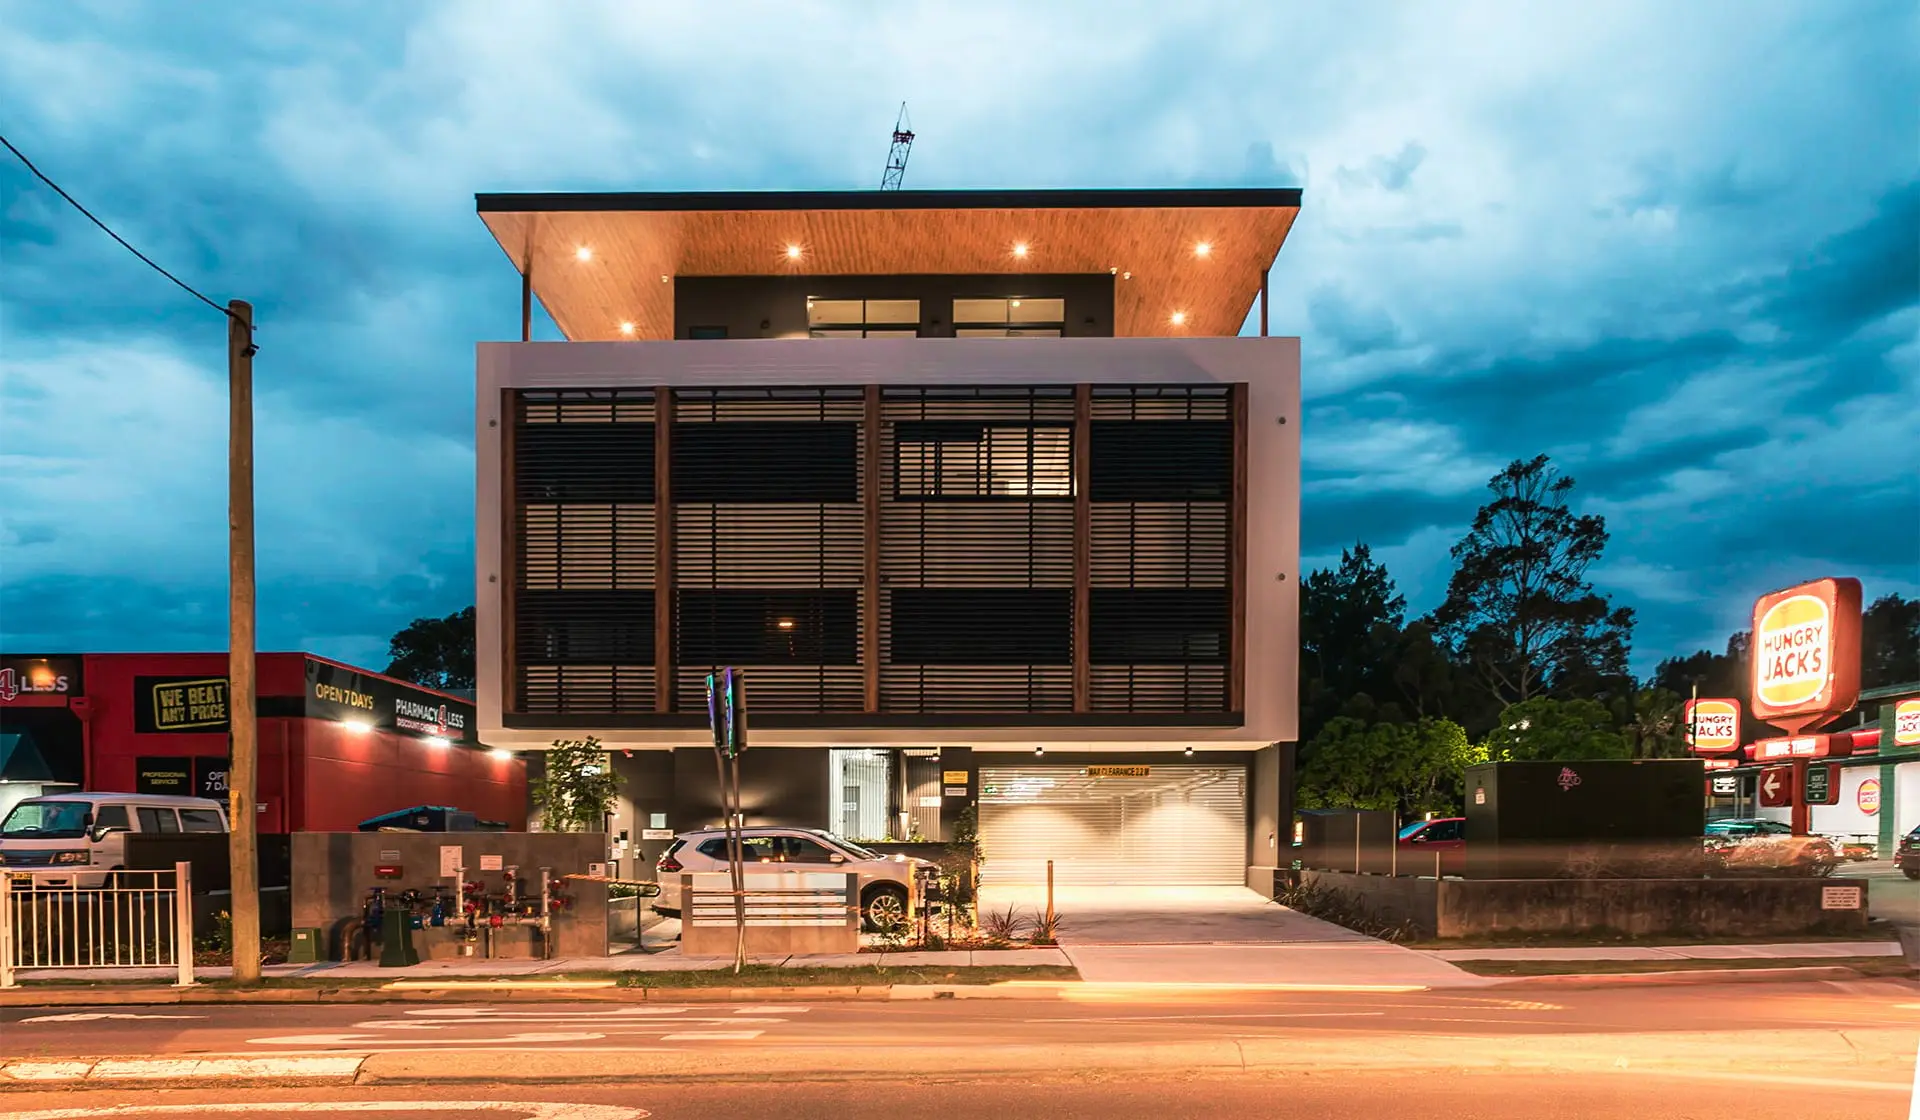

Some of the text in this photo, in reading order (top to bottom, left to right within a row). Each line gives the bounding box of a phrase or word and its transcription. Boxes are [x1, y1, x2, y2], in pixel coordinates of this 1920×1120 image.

[1764, 626, 1822, 653] HUNGRY
[1764, 647, 1821, 681] JACKS
[160, 686, 223, 707] WE BEAT
[315, 683, 373, 710] OPEN 7 DAYS
[162, 703, 226, 723] ANY PRICE
[395, 699, 438, 723] PHARMACY
[447, 714, 464, 728] LESS
[1697, 726, 1733, 736] ACKS
[1102, 767, 1135, 776] CLEARANCE
[205, 782, 211, 791] 7
